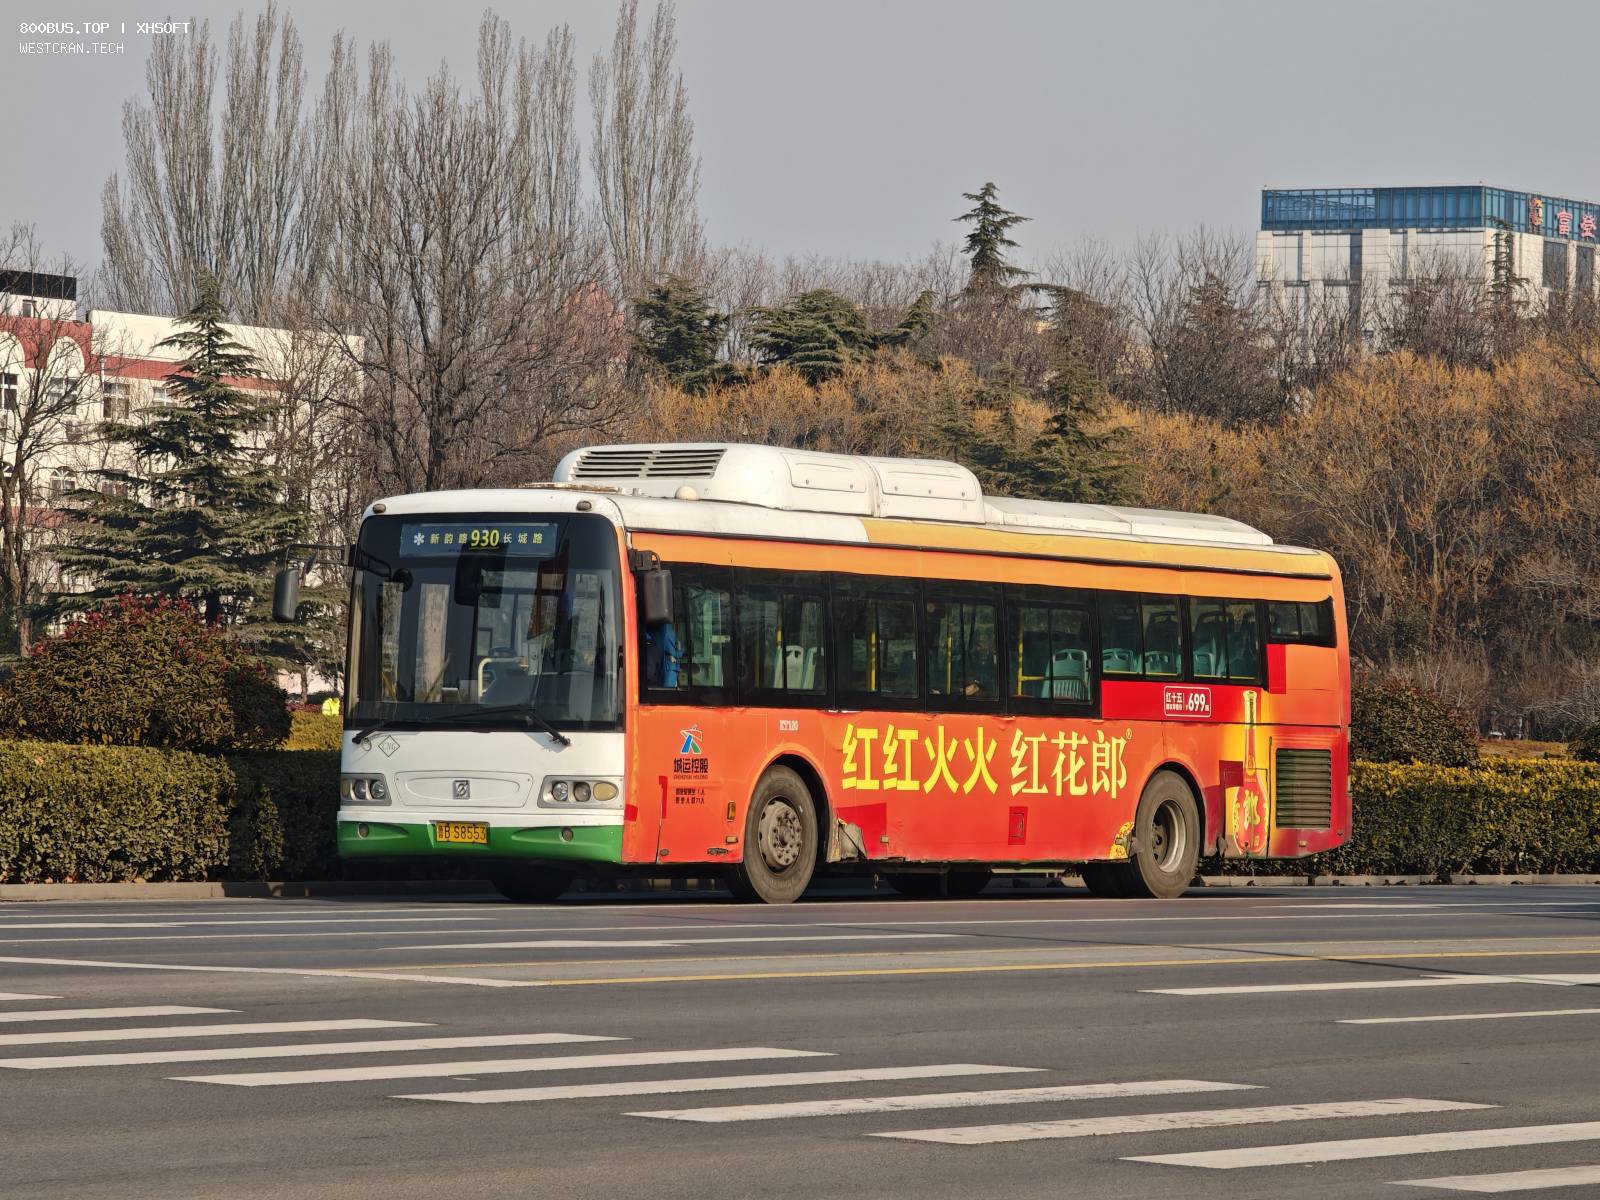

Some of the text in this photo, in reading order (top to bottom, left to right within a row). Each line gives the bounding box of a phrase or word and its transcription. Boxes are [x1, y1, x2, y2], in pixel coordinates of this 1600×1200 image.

[471, 529, 500, 547] 930
[503, 532, 544, 545] 长城路
[1165, 691, 1183, 703] 红十五
[673, 757, 709, 774] 城运控股
[841, 723, 999, 796] 红红火火
